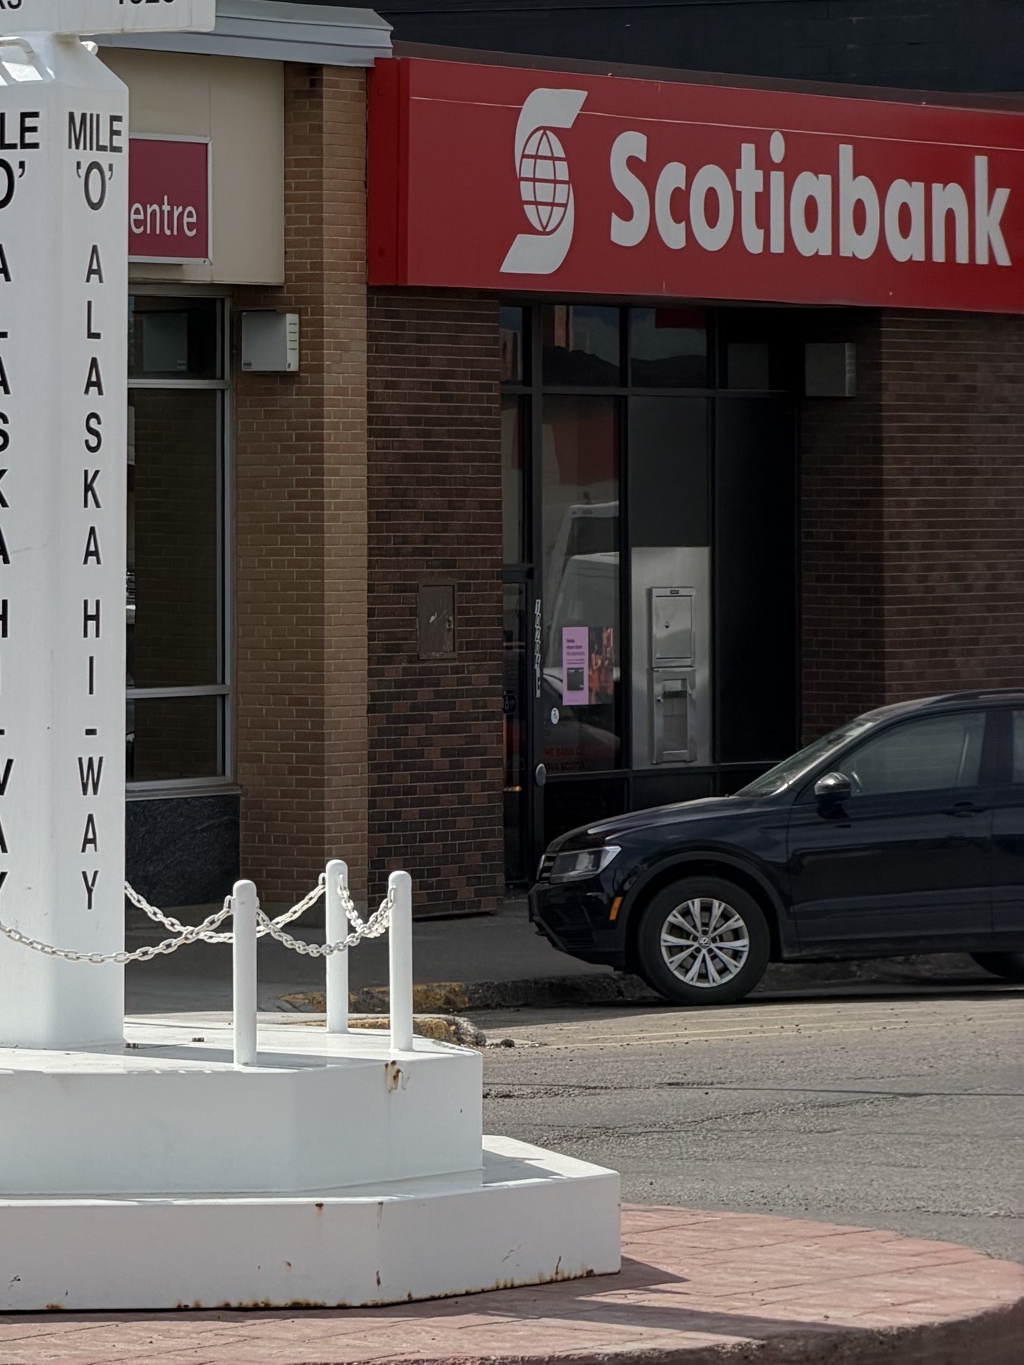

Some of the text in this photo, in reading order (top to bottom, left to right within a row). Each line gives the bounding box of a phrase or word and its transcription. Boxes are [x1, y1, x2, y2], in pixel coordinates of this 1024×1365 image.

[68, 112, 122, 153] MILE
[131, 196, 196, 236] entre
[611, 131, 1011, 266] Scotiabank
[83, 245, 103, 564] ALASKA
[546, 763, 560, 773] OVA
